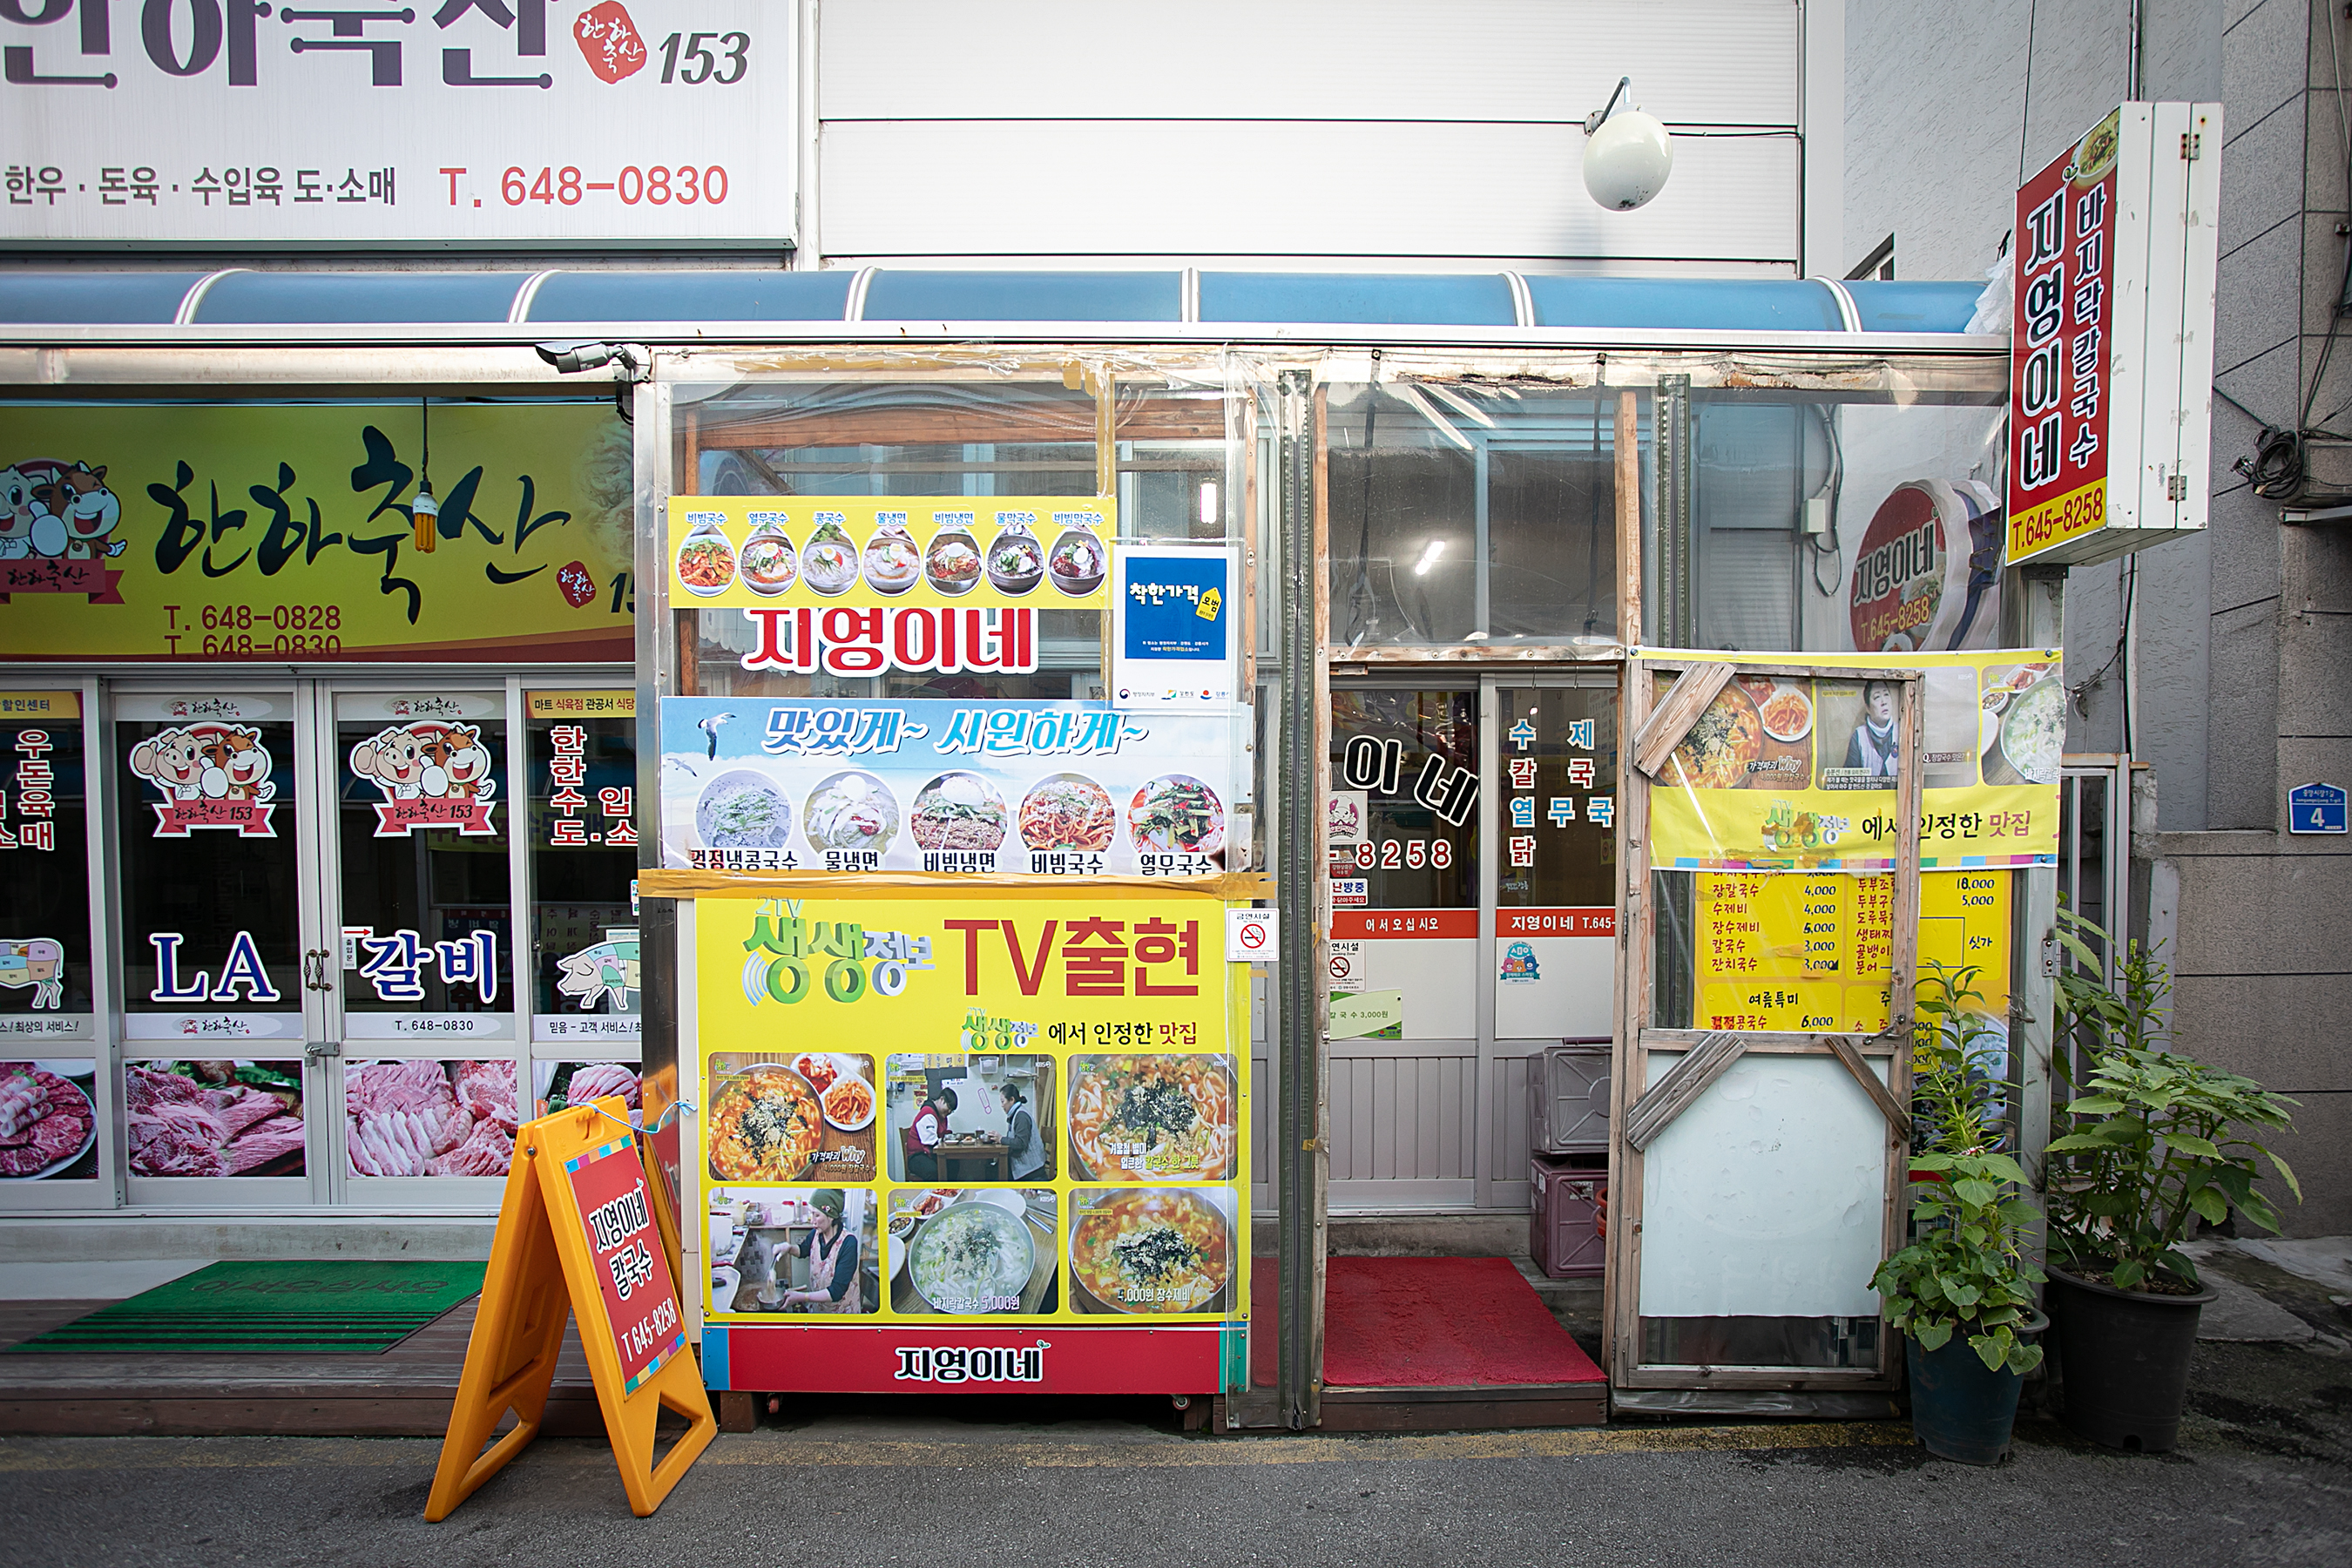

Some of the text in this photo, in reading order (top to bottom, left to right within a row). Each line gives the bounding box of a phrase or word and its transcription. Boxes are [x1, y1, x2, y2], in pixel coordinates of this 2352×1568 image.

[659, 31, 750, 85] 153
[4, 166, 66, 206] 한우
[98, 166, 157, 206] 돈육
[192, 166, 283, 206] 수입육
[440, 166, 729, 207] T. 648-0830
[2069, 183, 2105, 469] 바지락칼국수
[2020, 190, 2066, 490] 지영이네
[686, 511, 1105, 526] 비빔국수 열무국수 콩국수 물냉면 비빔냉면 물막국수 비빔막국수
[1854, 520, 1935, 607] 지영이네
[1130, 582, 1199, 605] 착한가격
[1202, 596, 1220, 612] 모범
[164, 606, 342, 631] T. 648-0828
[202, 636, 342, 659] 648-0830
[741, 608, 1038, 677] 지영이네
[3, 700, 51, 712] 할인센터
[534, 698, 635, 710] 마트 식육점 관공서 식당
[762, 706, 1148, 757] 맛있게~ 시원하게~
[1749, 755, 1801, 773] 가격파괴 Why
[230, 807, 253, 821] 153
[449, 805, 473, 818] 153
[2310, 808, 2325, 827] 4
[1920, 812, 1983, 840] 인정한
[1990, 810, 2031, 837] 맛집
[1509, 835, 1536, 868] 닭
[824, 850, 1213, 874] 물냉면 비빔냉면 비빔국수 열무국수
[1713, 883, 1836, 898] 장칼국수 4,000
[1713, 902, 1835, 916] 수제비 4,000
[1962, 895, 1994, 907] 5,000
[1511, 916, 1573, 930] 지영이네
[1713, 921, 1760, 935] 장수제비
[1712, 939, 1746, 953] 칼국수
[1969, 936, 1992, 950] 싯가
[149, 929, 497, 1004] LA 갈비
[742, 916, 1200, 1004] 생생정보 TV출현
[1712, 957, 1758, 971] 잔치국수
[1856, 962, 1877, 975] 문어
[1748, 990, 1798, 1008] 여름특미
[16, 1021, 79, 1032] 최상의 서비스!
[395, 1020, 474, 1031] T. 648-0830
[550, 1022, 567, 1033] 믿음
[579, 1022, 598, 1033] 고객
[601, 1022, 633, 1033] 서비스!
[1801, 1015, 1833, 1028] 6,000
[962, 1016, 1196, 1051] 생생정보 에서 인정한 맛집
[811, 1146, 865, 1164] 가격파괴 Why
[1110, 1143, 1146, 1155] 겨울철 별미
[1146, 1157, 1169, 1169] 칼국수
[1172, 1157, 1181, 1168] 한
[588, 1186, 650, 1254] 지영이네
[609, 1239, 653, 1301] 칼국수
[933, 1295, 1019, 1310] 바지락칼국수 5,000원
[632, 1297, 676, 1355] 645-8258
[894, 1345, 1043, 1383] 지영이네
